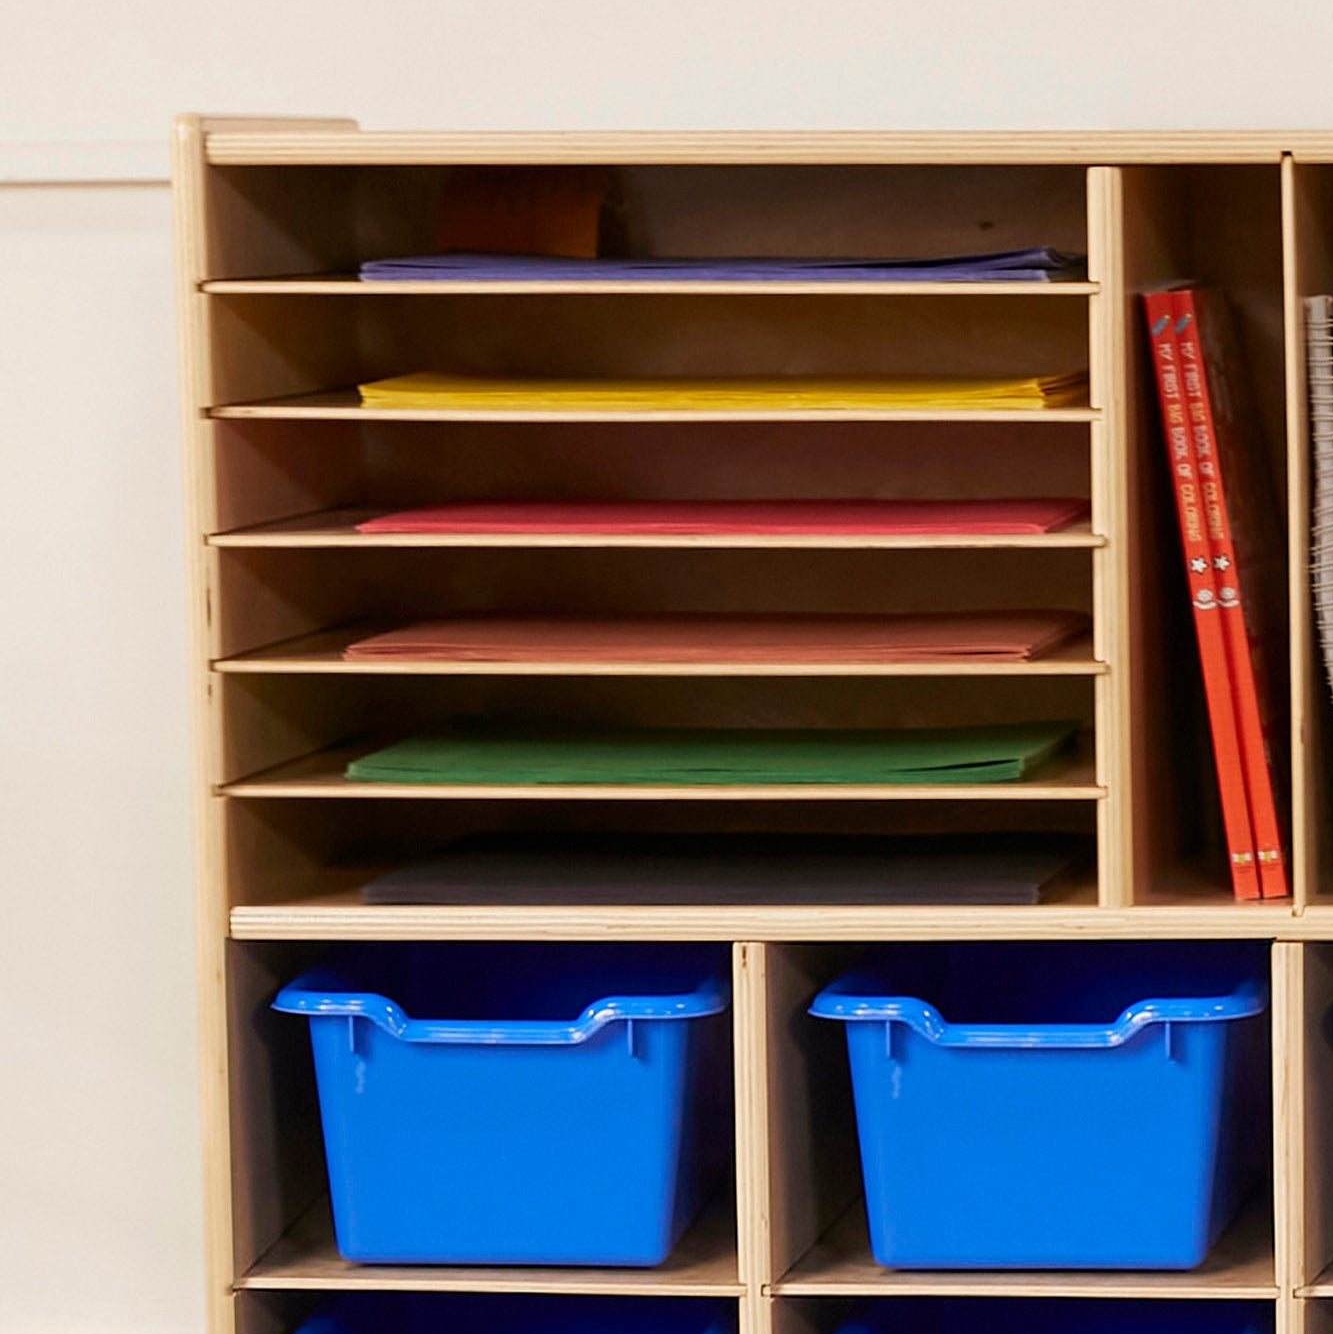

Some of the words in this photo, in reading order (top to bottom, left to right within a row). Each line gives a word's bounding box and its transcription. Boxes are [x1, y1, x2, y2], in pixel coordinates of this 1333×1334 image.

[1158, 343, 1173, 361] MY
[1180, 341, 1195, 359] MY
[1161, 365, 1180, 398] FIRST
[1184, 364, 1202, 397] FIRST
[1167, 403, 1184, 424] BIG
[1189, 402, 1206, 422] BIG
[1170, 427, 1189, 460] BOOK
[1192, 425, 1211, 458] BOOK
[1176, 463, 1193, 480] OF
[1199, 461, 1215, 479] OF
[1180, 483, 1202, 542] COLORING
[1202, 482, 1224, 540] COLORING
